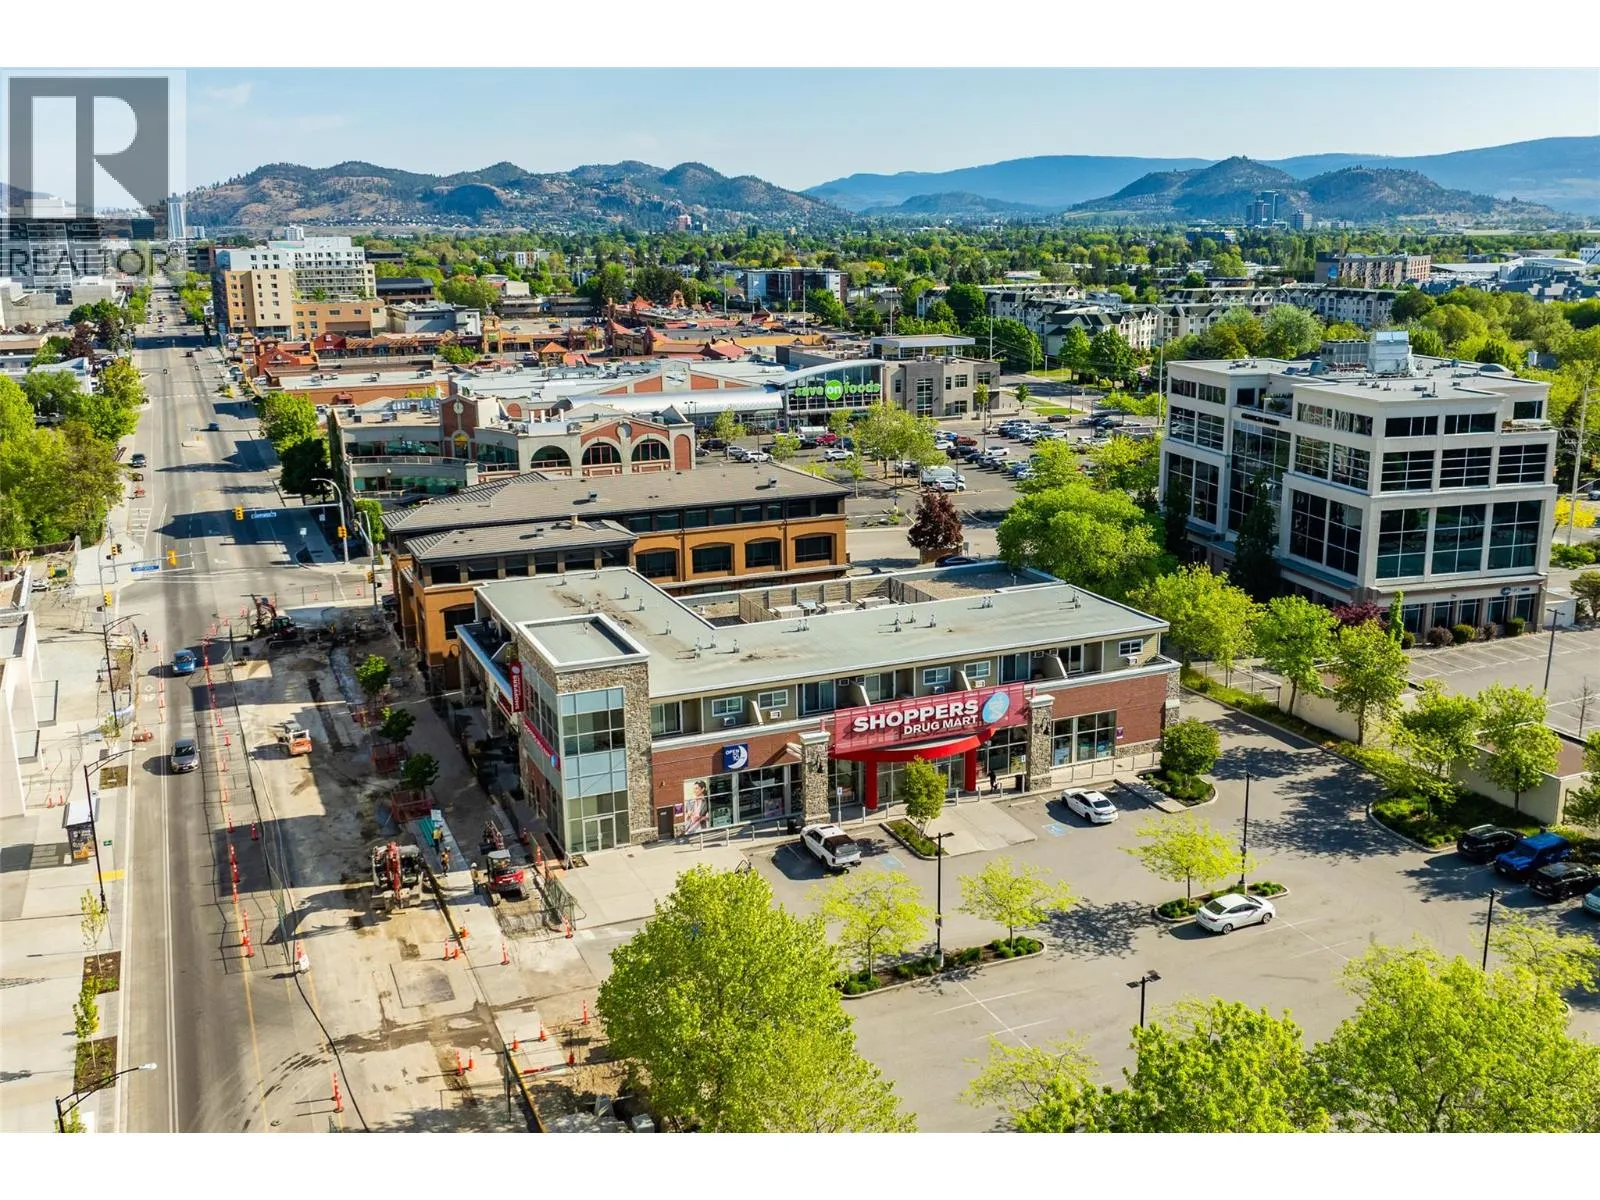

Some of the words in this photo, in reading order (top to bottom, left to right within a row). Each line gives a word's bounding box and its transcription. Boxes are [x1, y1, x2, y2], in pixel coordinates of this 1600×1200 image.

[795, 386, 824, 396] save
[827, 385, 842, 393] on
[844, 380, 881, 393] foods
[853, 699, 979, 733] SHOPPERS
[903, 722, 940, 735] DRUG
[942, 715, 979, 729] MART
